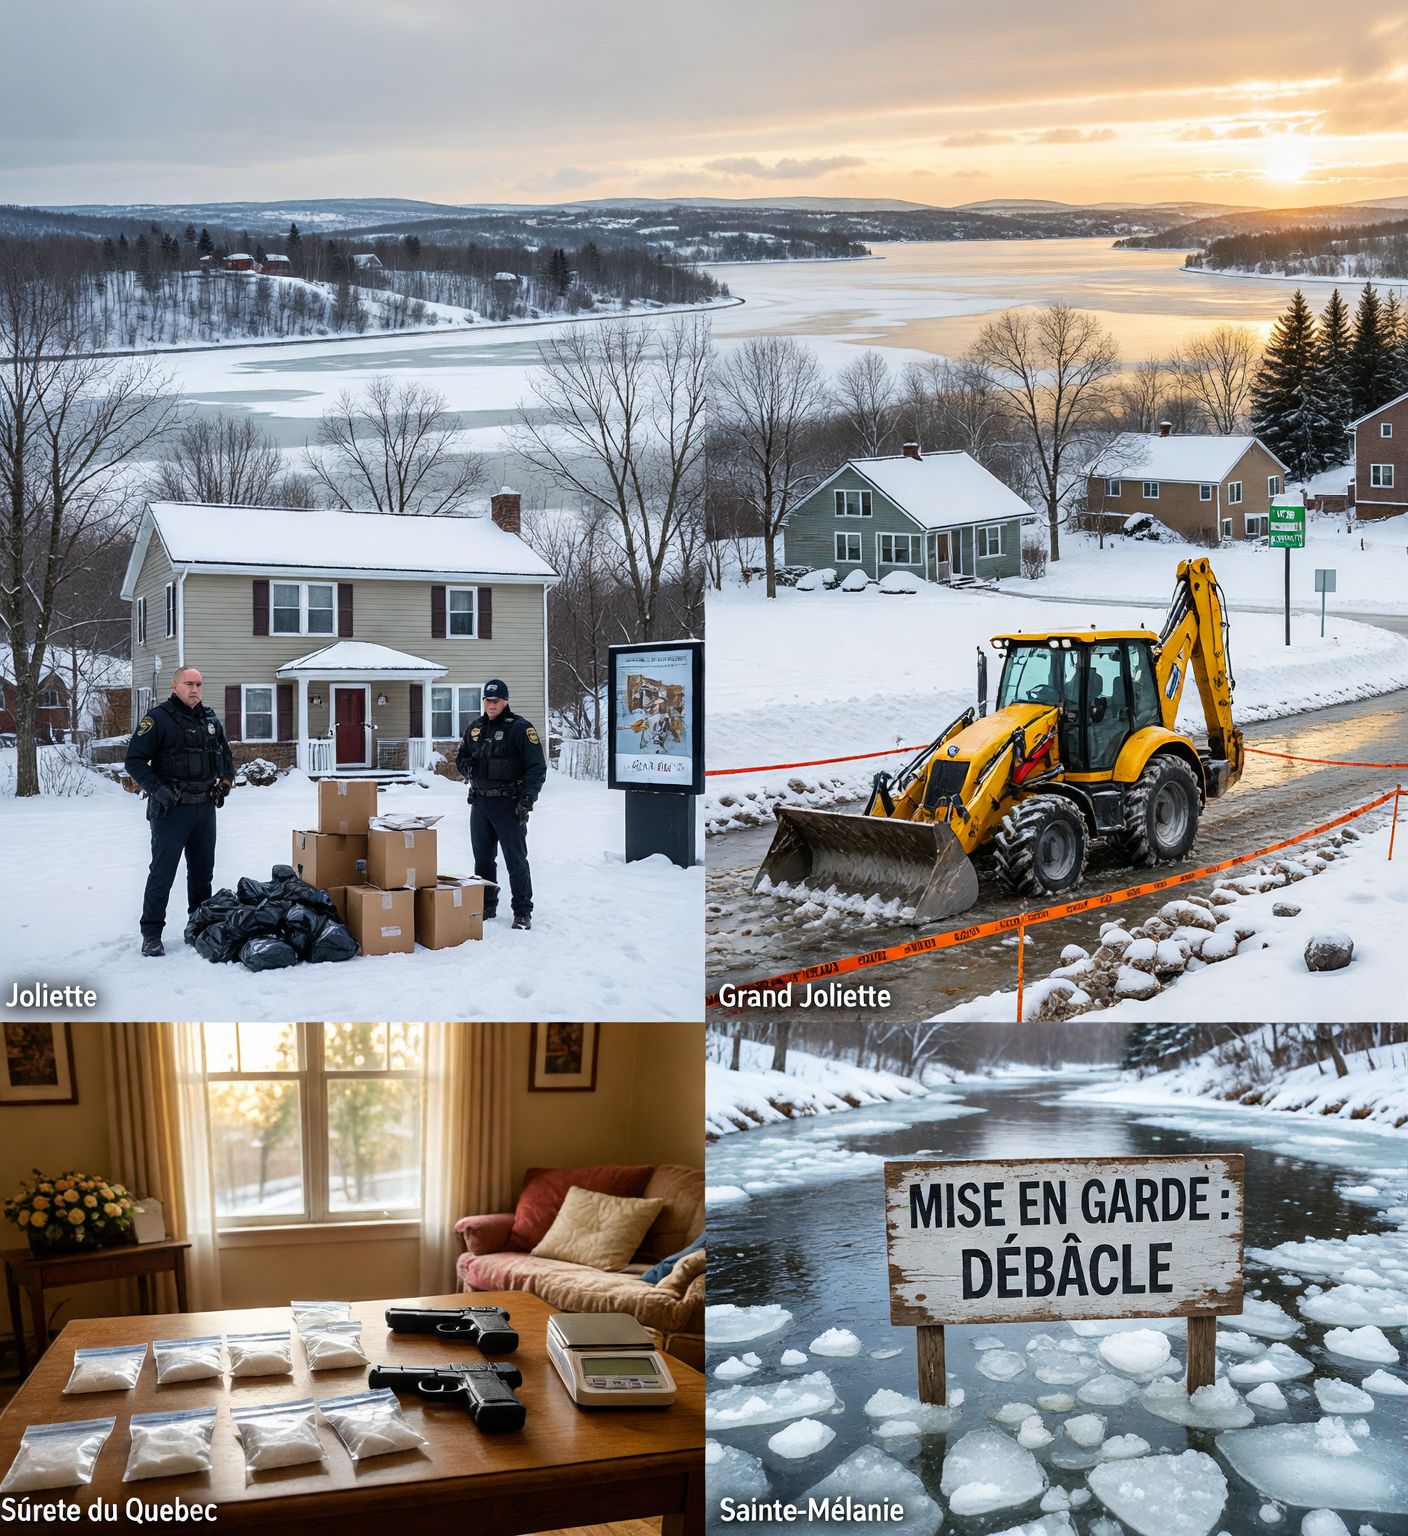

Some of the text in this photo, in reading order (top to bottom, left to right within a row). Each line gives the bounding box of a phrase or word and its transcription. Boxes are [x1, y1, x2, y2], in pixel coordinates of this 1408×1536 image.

[909, 1182, 1006, 1229] MISE
[1019, 1180, 1067, 1226] EN
[1081, 1176, 1210, 1224] GARDE
[961, 1232, 1173, 1300] DÉBÂCLE
